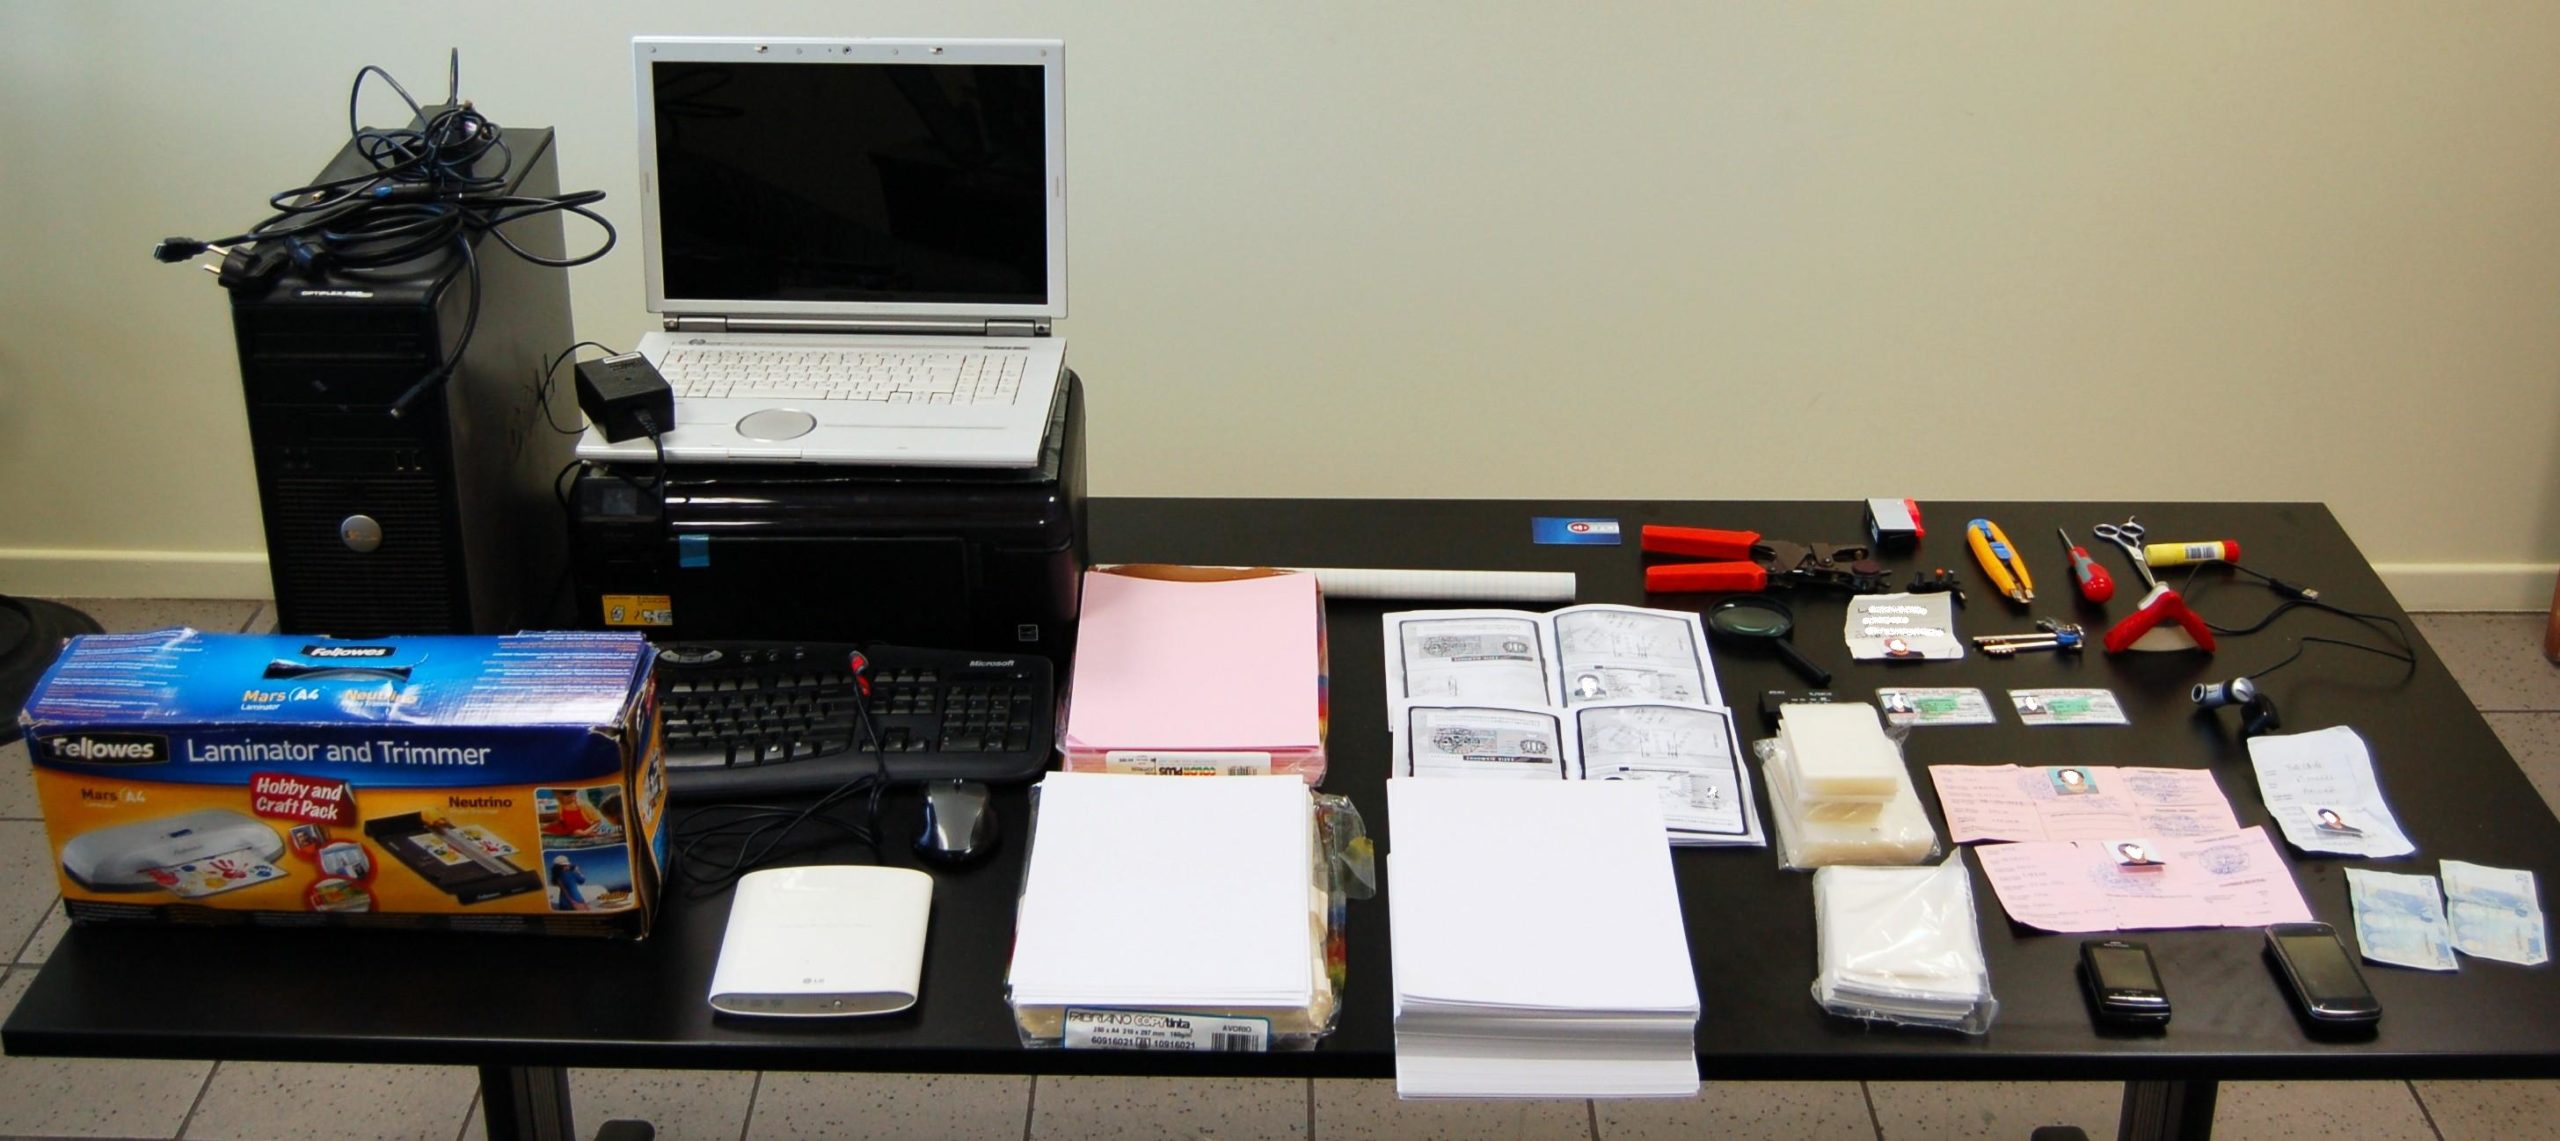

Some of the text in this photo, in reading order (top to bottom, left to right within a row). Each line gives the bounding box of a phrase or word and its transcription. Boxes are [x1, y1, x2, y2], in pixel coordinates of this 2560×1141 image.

[310, 647, 387, 657] Fellowes
[969, 659, 1015, 667] Microsoft
[243, 690, 286, 703] Mars
[240, 703, 280, 711] Laminator
[53, 737, 154, 760] Fellowes
[187, 738, 491, 766] Laminator and Trimmer
[80, 788, 118, 802] Mars
[256, 777, 344, 801] Hobby and
[256, 796, 339, 820] Craft Pack
[448, 795, 513, 808] Neutrino
[1069, 1010, 1132, 1025] FABRIANO
[1222, 1025, 1252, 1033] AVORIO
